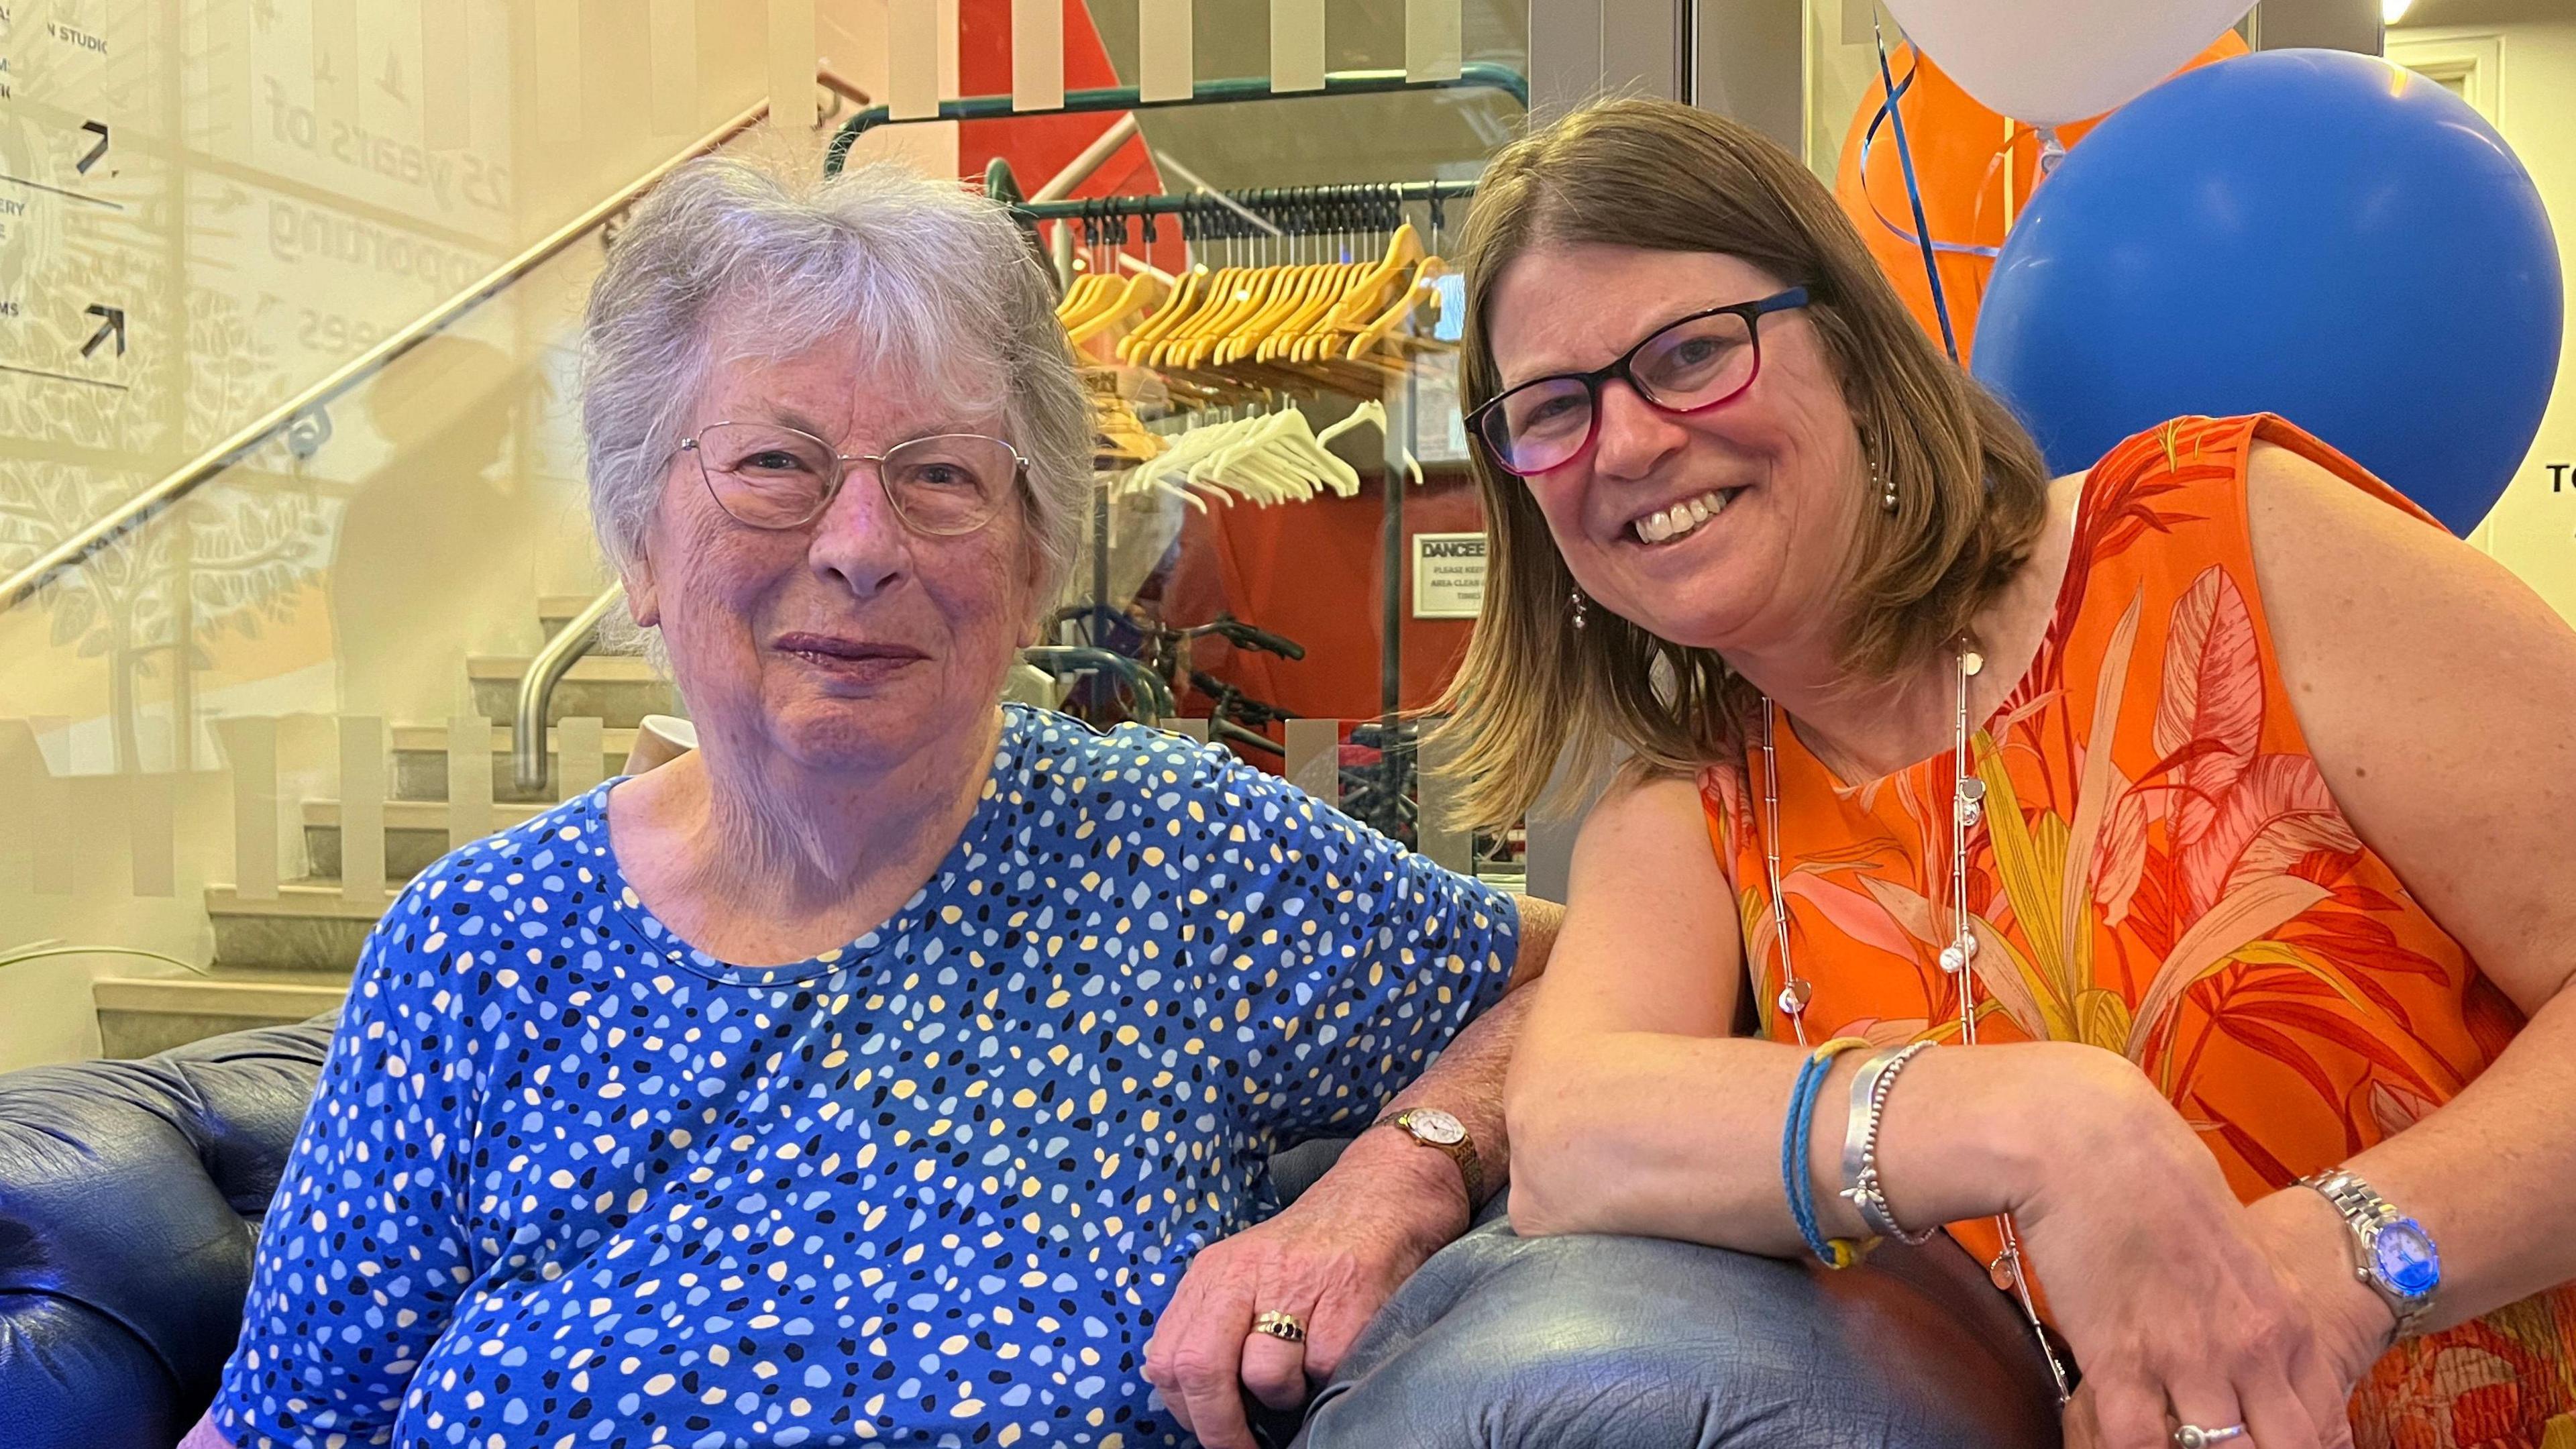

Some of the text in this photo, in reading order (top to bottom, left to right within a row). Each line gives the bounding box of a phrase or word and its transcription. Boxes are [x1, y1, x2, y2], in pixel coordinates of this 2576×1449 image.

[2546, 463, 2576, 492] T
[1434, 566, 1463, 574] PLEASE
[1454, 579, 1480, 587] CLEAR
